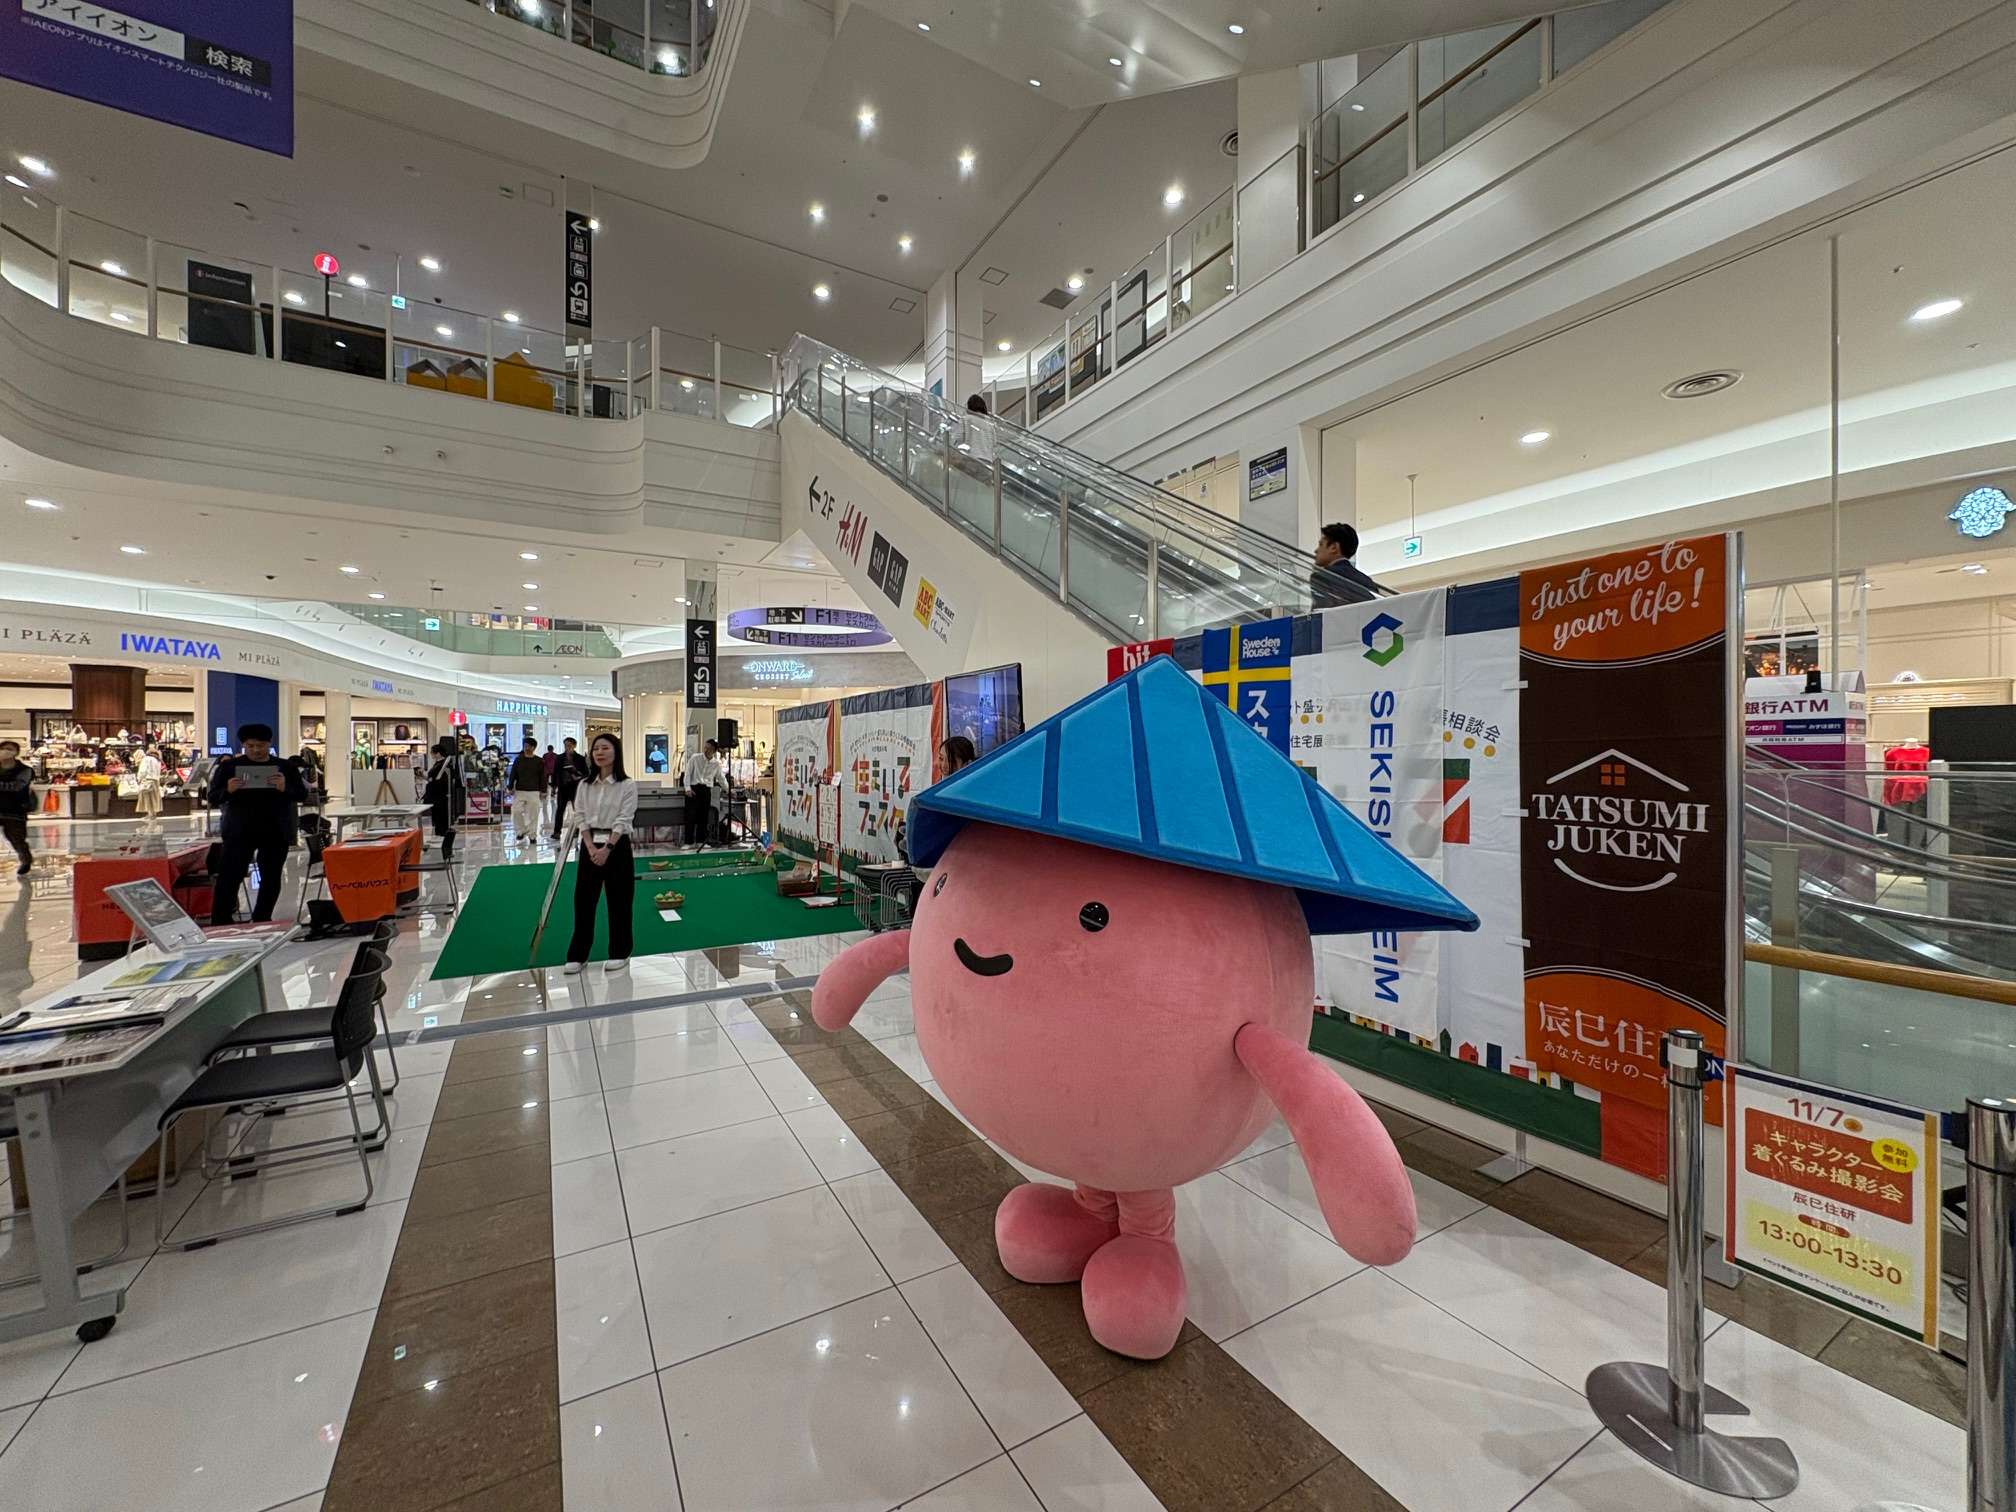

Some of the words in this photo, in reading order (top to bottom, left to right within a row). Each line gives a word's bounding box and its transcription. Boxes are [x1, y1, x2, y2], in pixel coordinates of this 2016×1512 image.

[206, 46, 253, 76] 検索
[820, 491, 835, 520] 2F
[836, 501, 868, 568] H&M
[919, 586, 933, 609] ABC
[1531, 567, 1597, 621] Just
[1598, 559, 1654, 594] one
[1648, 540, 1698, 574] to
[816, 609, 831, 624] F1
[1553, 608, 1624, 651] your
[120, 633, 221, 661] IWATAYA
[1242, 636, 1281, 650] Sweden
[1242, 647, 1272, 659] House
[496, 700, 548, 715] HAPPINESS
[1368, 690, 1395, 839] SEKIS
[1532, 794, 1711, 833] TATSUMI
[1547, 825, 1687, 864] JUKEN
[1539, 1001, 1668, 1060] 辰巳住
[1787, 1097, 1845, 1128] 11/7
[1769, 1130, 1884, 1171] キャラクター
[1752, 1143, 1905, 1204] 着ぐるみ撮影会
[1792, 1192, 1858, 1222] 辰巳住研
[1758, 1219, 1903, 1286] 13:00-13:30
